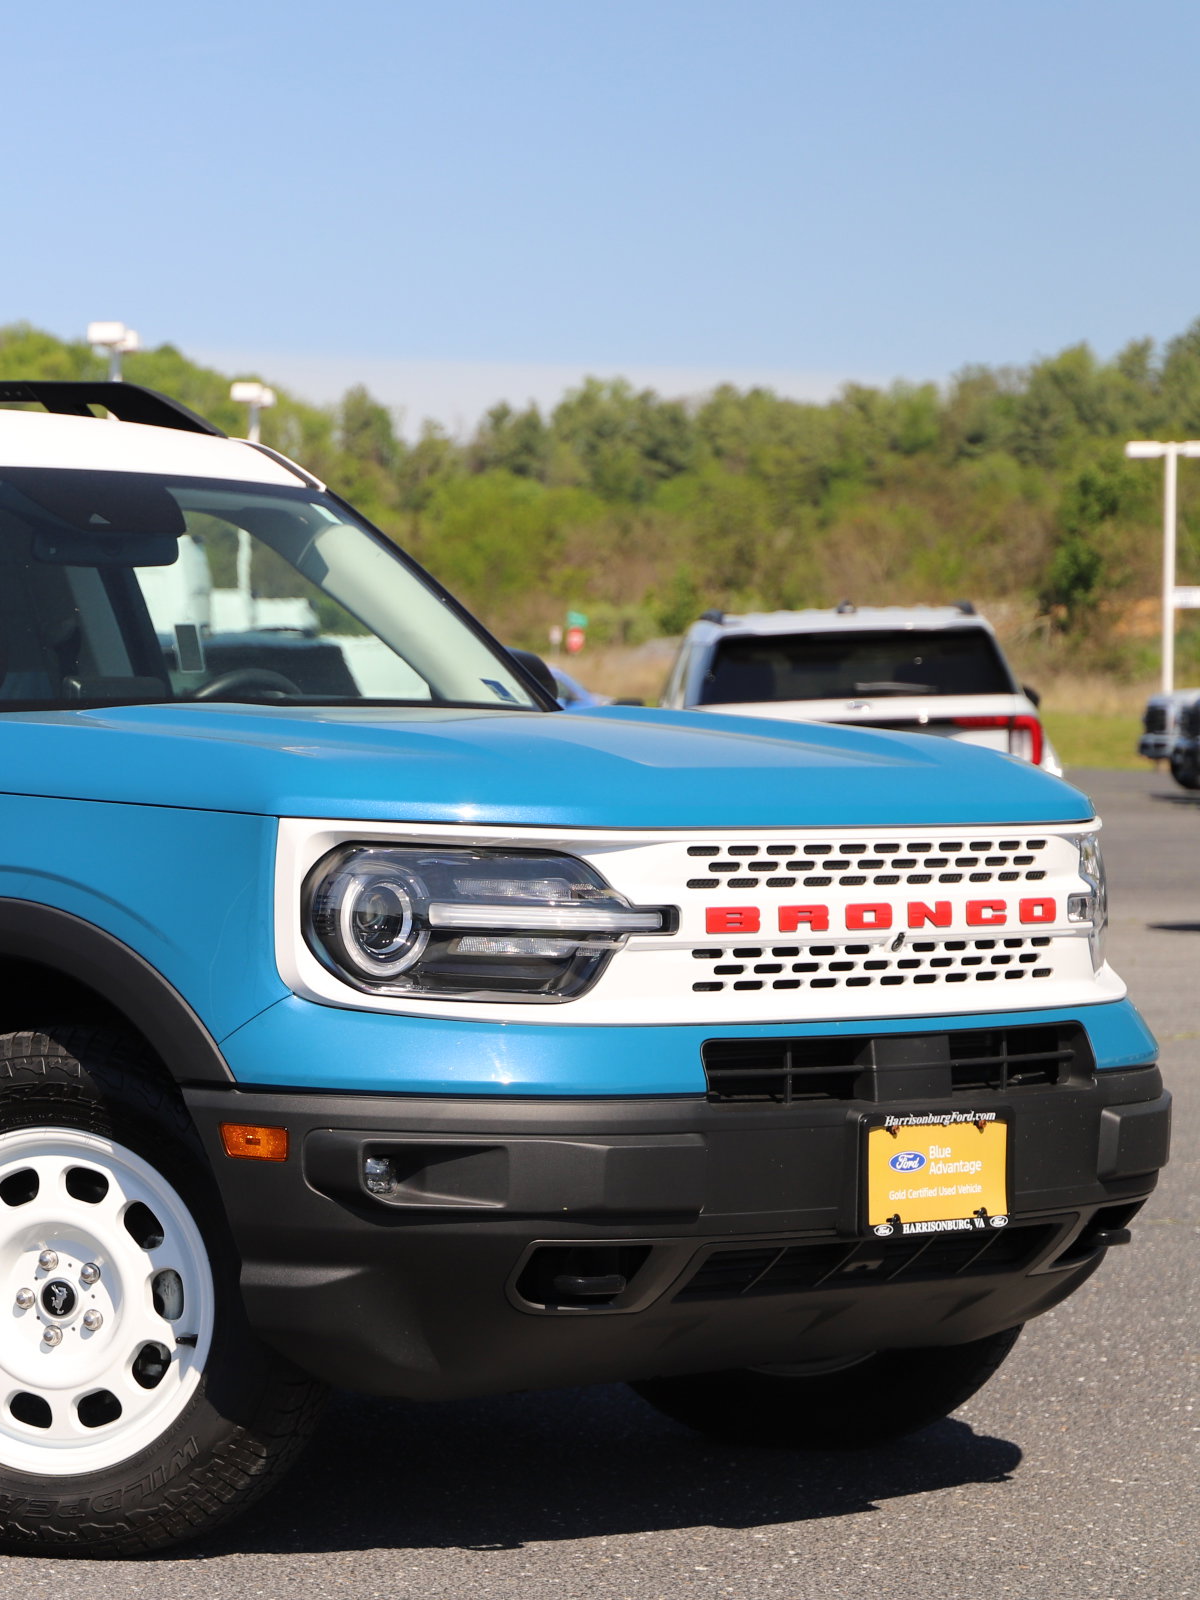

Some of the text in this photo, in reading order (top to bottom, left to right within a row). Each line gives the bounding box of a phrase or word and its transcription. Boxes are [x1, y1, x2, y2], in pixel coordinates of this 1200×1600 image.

[705, 897, 1057, 934] BRONCO
[885, 1111, 996, 1126] HarrisonburgFord.com
[928, 1145, 952, 1159] Blue
[896, 1154, 920, 1170] Ford
[928, 1160, 982, 1175] Advantage
[888, 1183, 982, 1201] Gold Certified Used Vehicle
[903, 1218, 985, 1234] HARRISONBURG, VA
